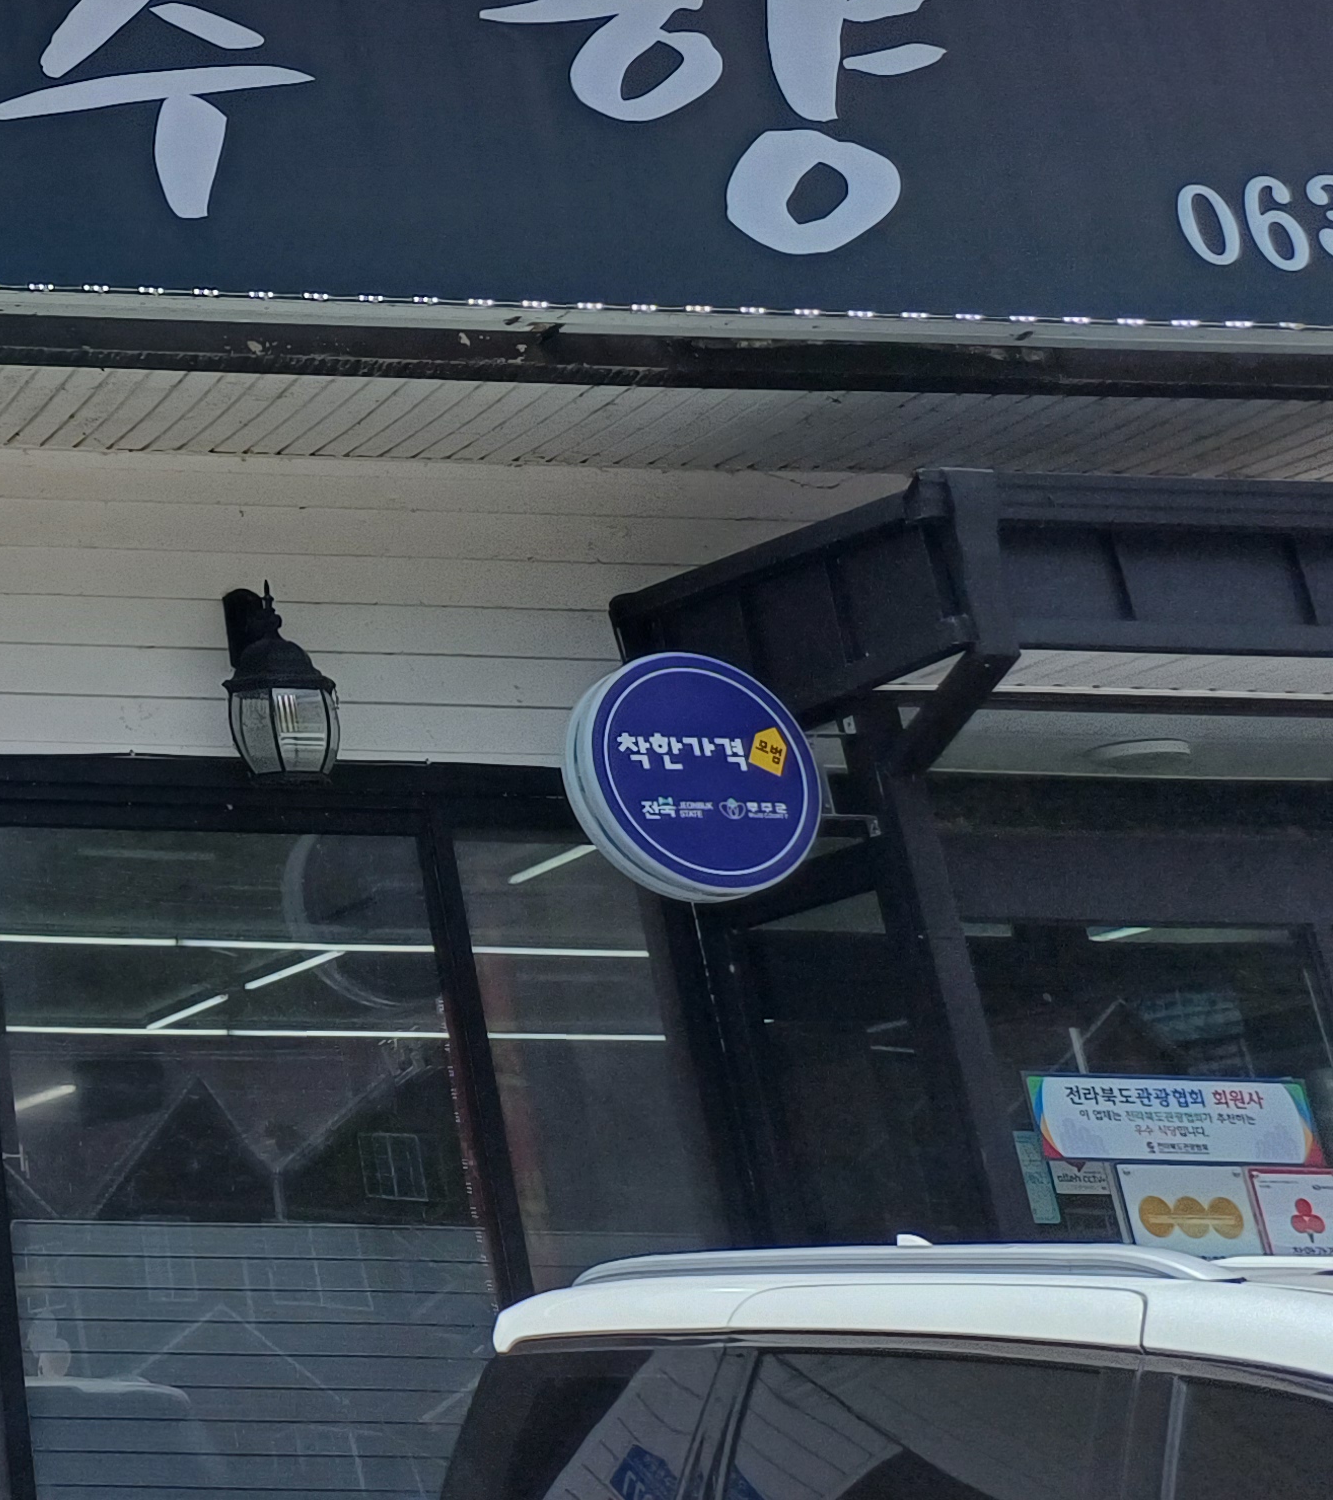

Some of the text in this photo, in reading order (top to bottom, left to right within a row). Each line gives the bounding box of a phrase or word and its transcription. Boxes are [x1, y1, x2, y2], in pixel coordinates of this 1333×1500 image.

[617, 733, 748, 771] 착한가격
[755, 739, 783, 765] 모범
[641, 797, 677, 819] 전북
[1064, 1085, 1264, 1110] 전라북도관광협회 회원사
[1079, 1109, 1090, 1121] 이
[1093, 1109, 1122, 1122] 업체는
[1216, 1112, 1256, 1126] 추천하는
[1134, 1124, 1154, 1135] 우수
